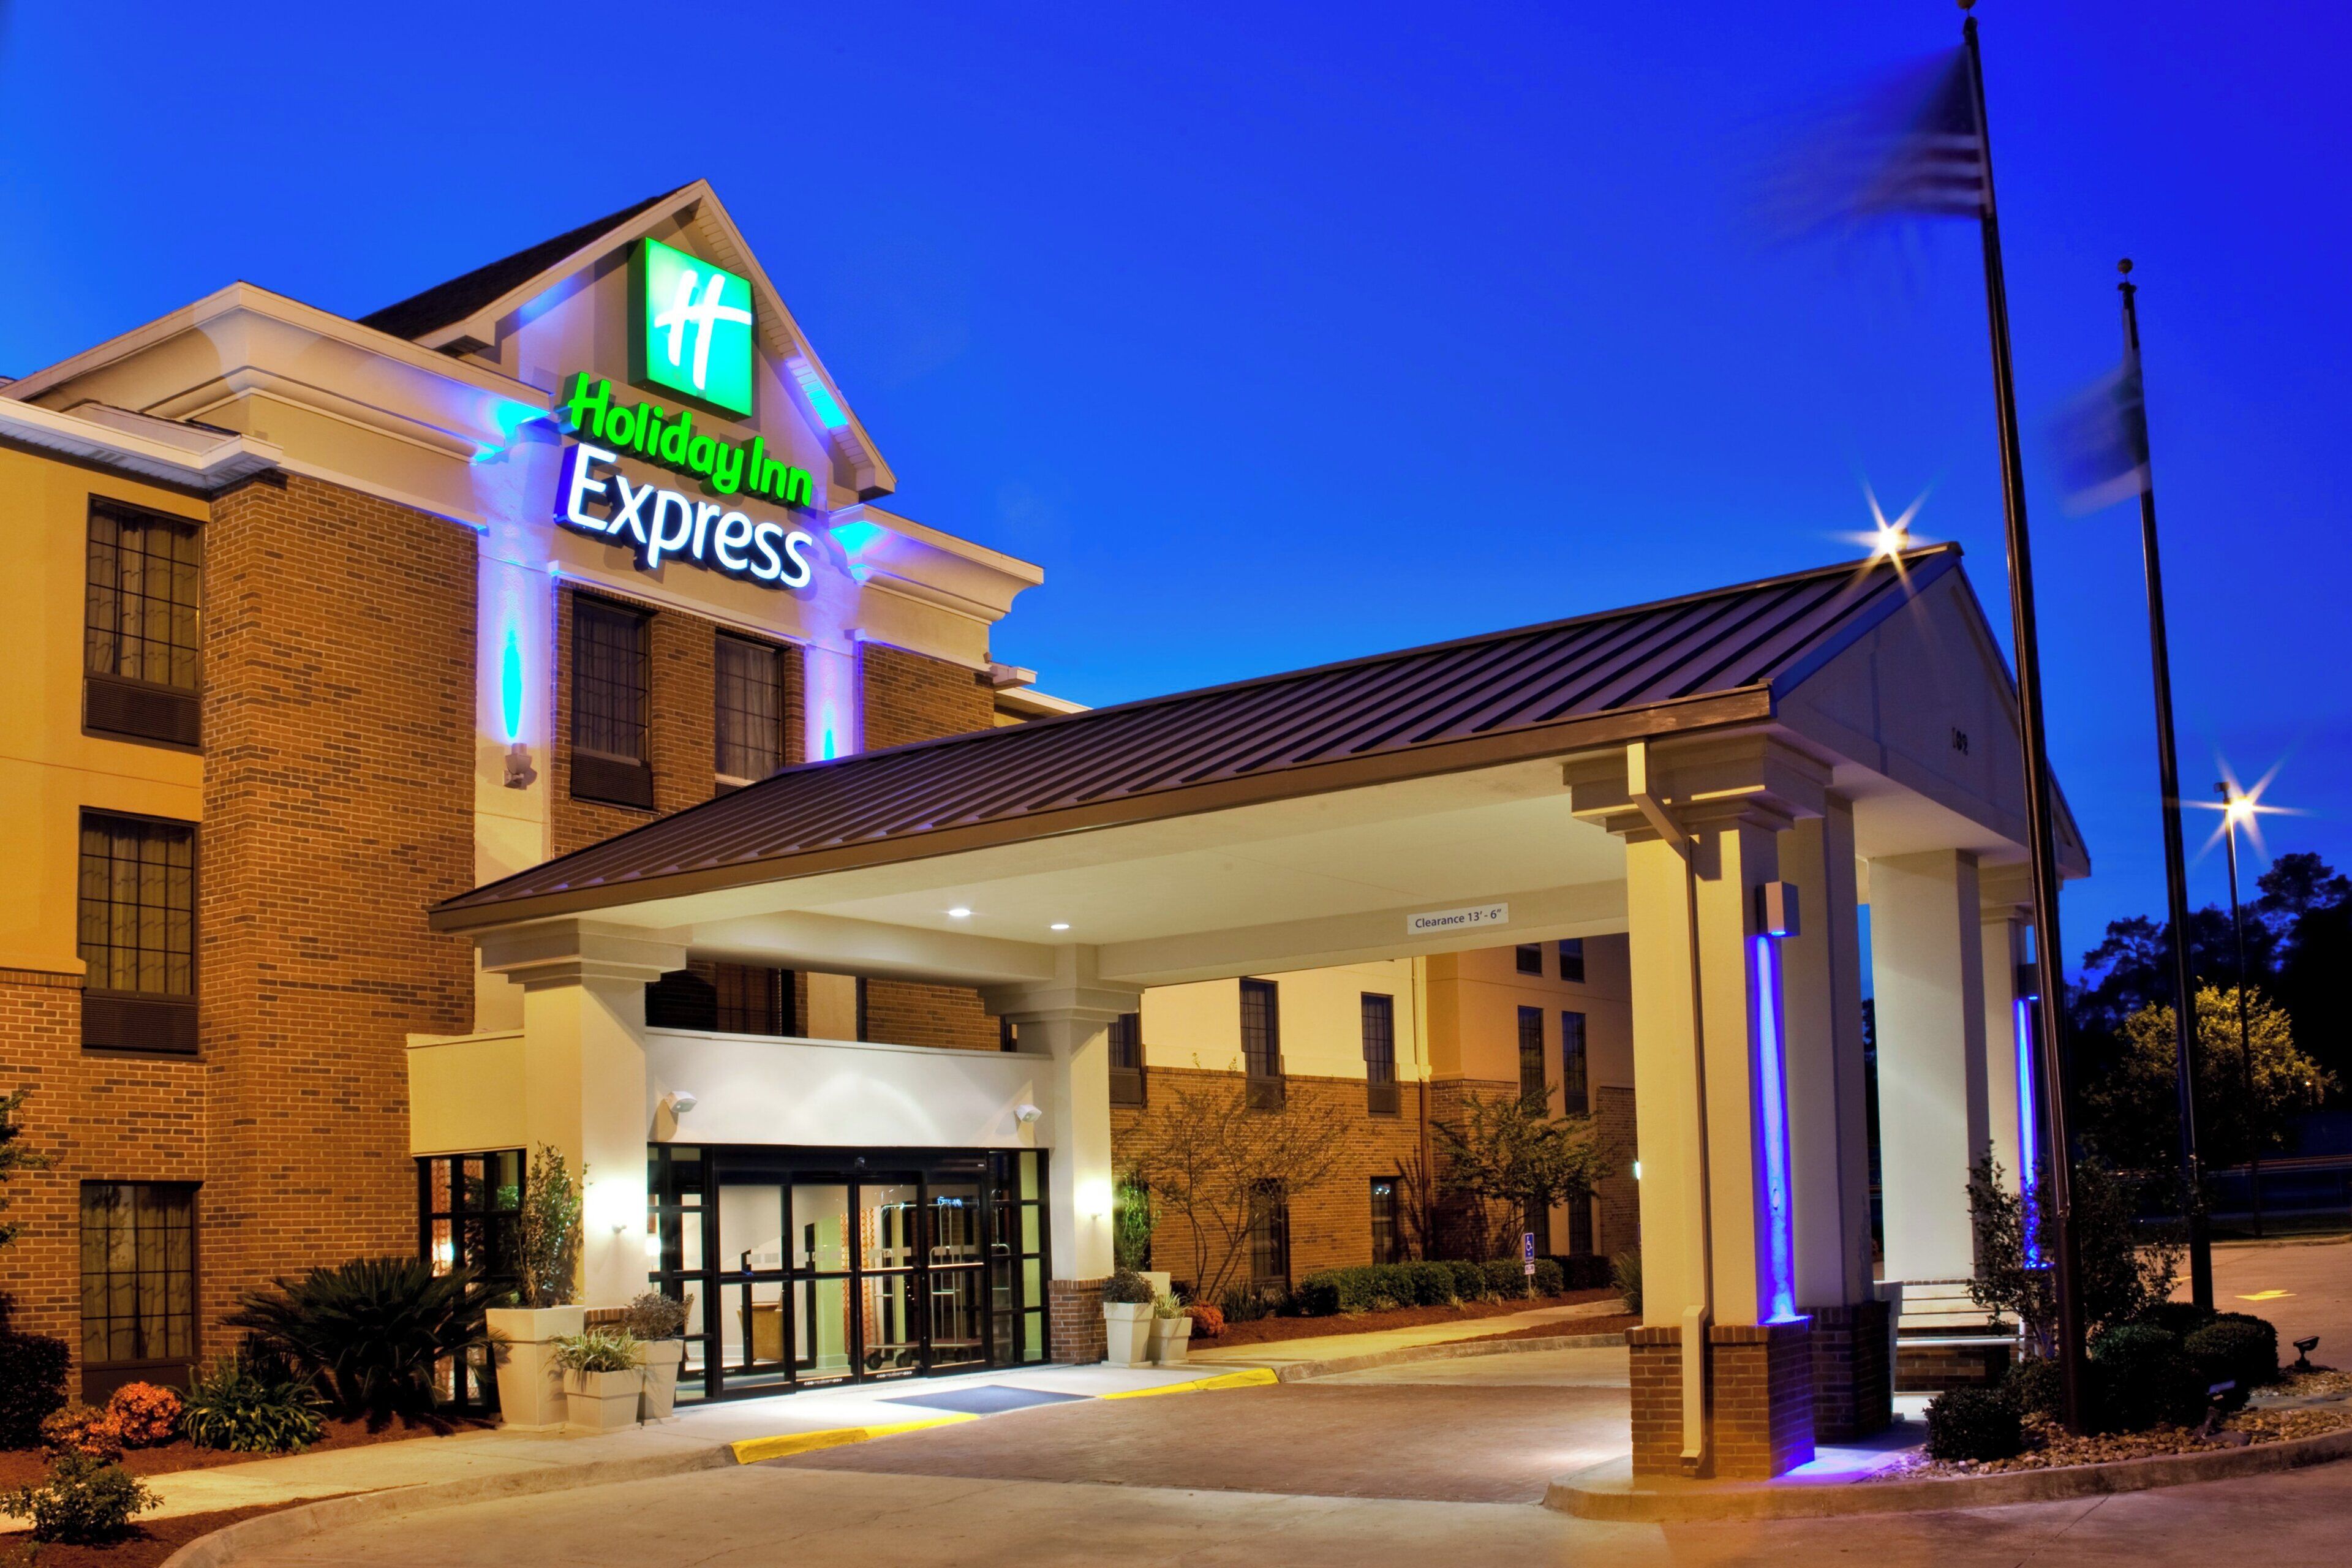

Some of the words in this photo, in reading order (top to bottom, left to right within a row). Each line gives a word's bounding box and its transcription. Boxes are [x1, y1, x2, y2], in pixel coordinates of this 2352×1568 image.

[654, 270, 752, 390] H
[568, 371, 744, 494] Holiday
[750, 435, 813, 507] Inn
[567, 443, 813, 588] Express
[1415, 914, 1465, 929] Clearance
